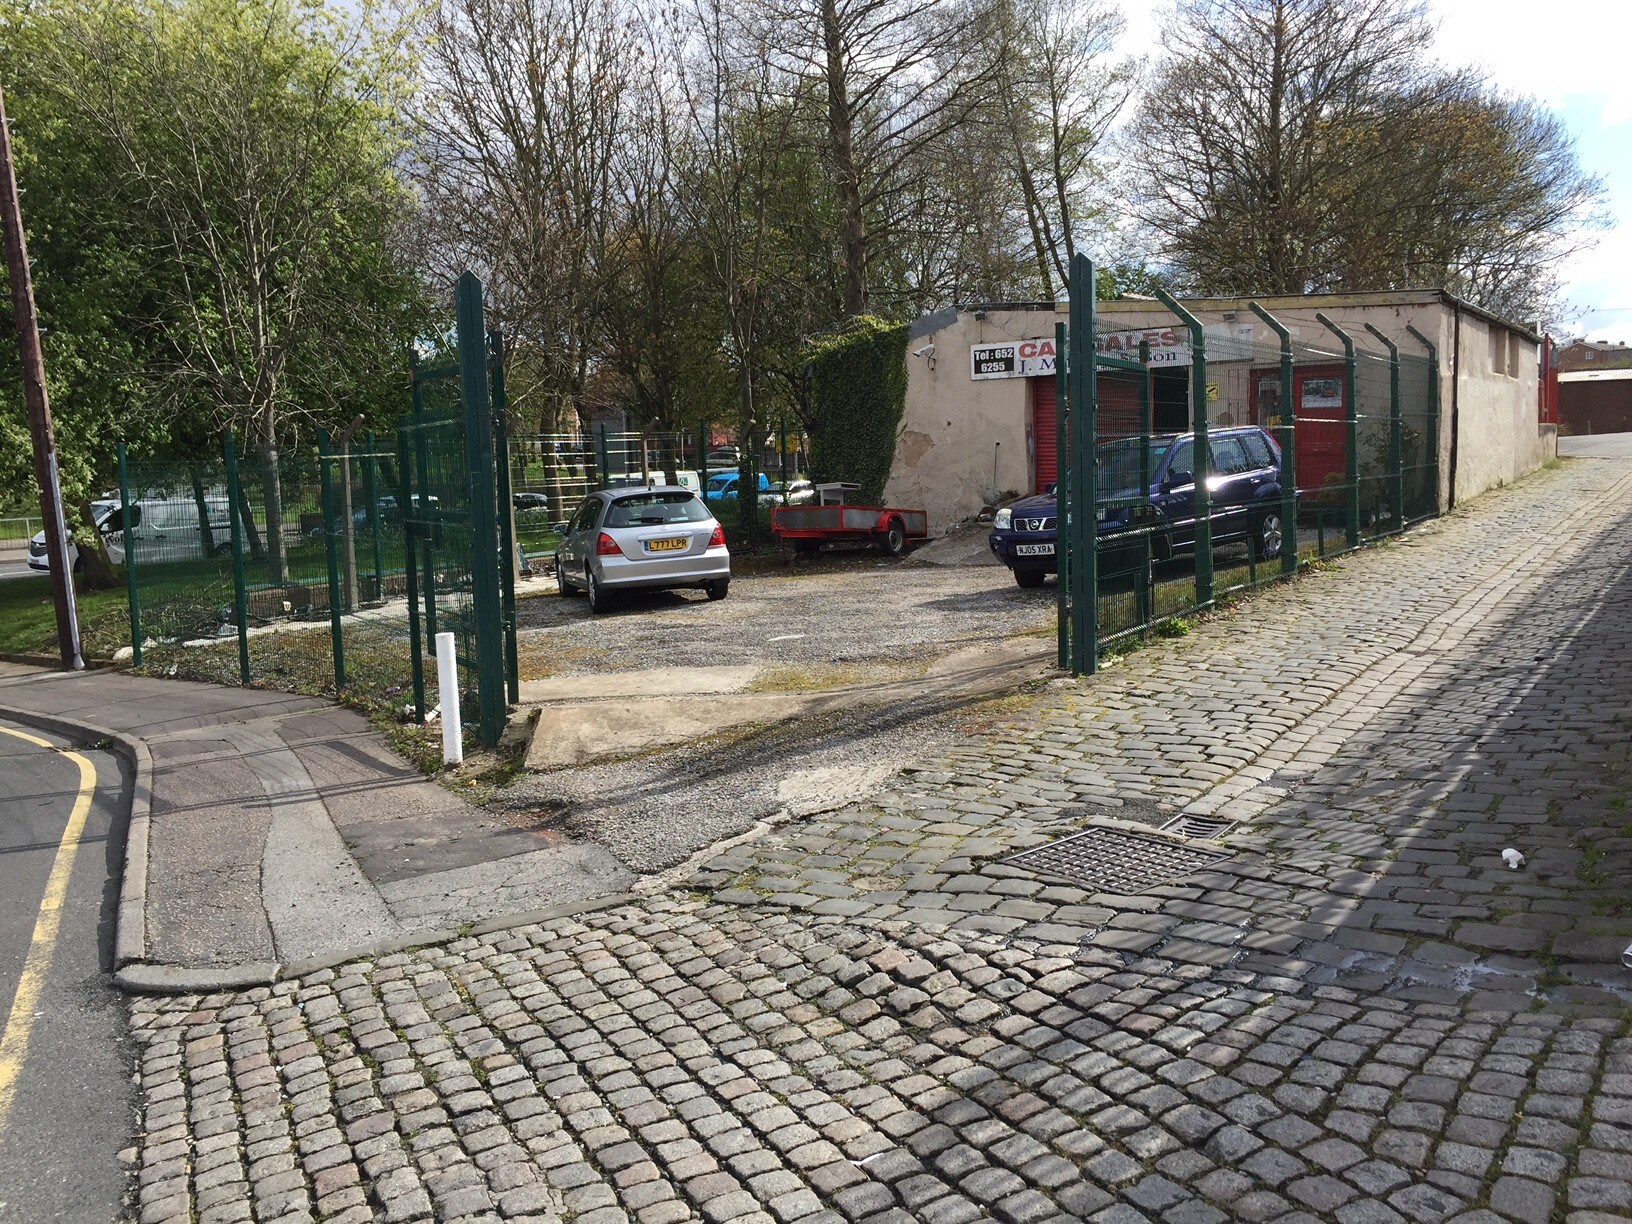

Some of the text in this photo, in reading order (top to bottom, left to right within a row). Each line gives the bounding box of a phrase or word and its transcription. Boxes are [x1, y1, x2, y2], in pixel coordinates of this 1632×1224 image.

[995, 348, 1014, 359] 652
[1019, 341, 1057, 358] CA
[981, 361, 1006, 373] 6255
[649, 539, 687, 549] L777 LPR
